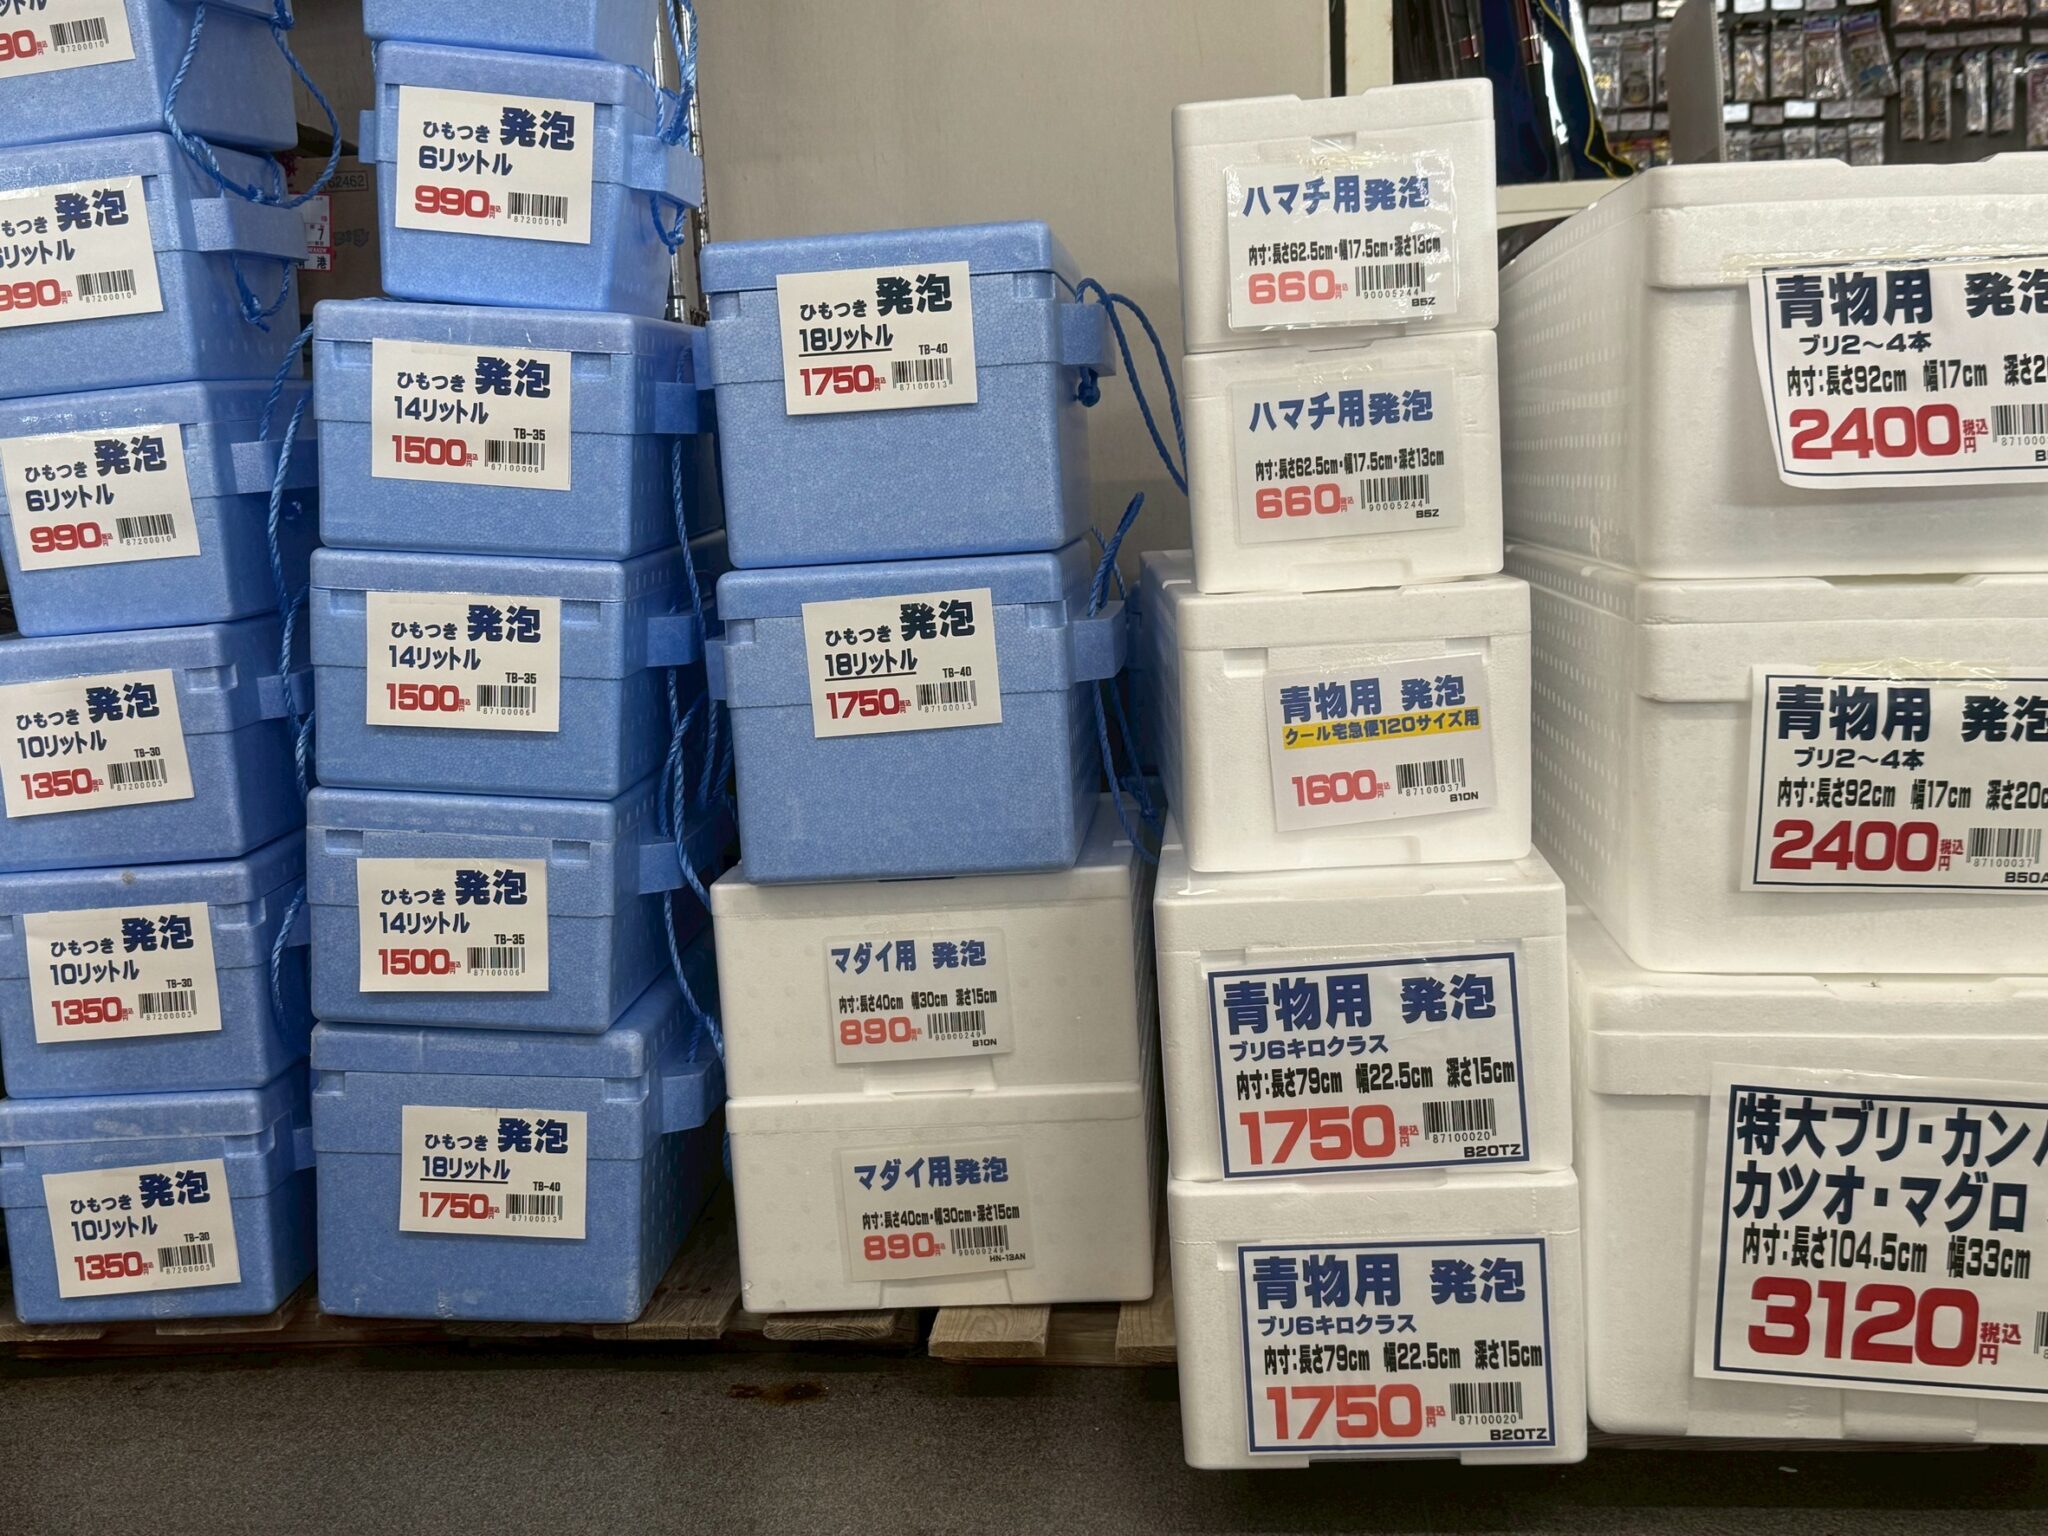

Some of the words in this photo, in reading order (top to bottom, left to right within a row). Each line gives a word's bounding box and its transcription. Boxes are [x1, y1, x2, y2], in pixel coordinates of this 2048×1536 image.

[423, 121, 490, 143] ひもつき
[500, 107, 574, 151] 発泡
[419, 145, 513, 176] 6リットル
[55, 189, 129, 232] 発泡
[415, 185, 490, 218] 990
[1243, 175, 1429, 217] ハマチ用発泡
[514, 217, 561, 226] 87200010
[801, 300, 867, 321] ひもつき
[876, 274, 952, 316] 発泡
[1249, 269, 1335, 305] 660
[1775, 269, 1933, 328] 青物用
[1964, 269, 2048, 318] 発泡
[799, 324, 893, 352] 18リットル
[918, 343, 948, 355] TB-40
[397, 372, 465, 392] ひもつき
[475, 357, 550, 398] 発泡
[800, 364, 875, 396] 1750
[1923, 360, 1987, 392] 幅17cm
[2004, 354, 2048, 387] 深さ2
[395, 396, 489, 424] 14リットル
[1249, 389, 1433, 432] ハマチ用発泡
[513, 428, 545, 440] TB-35
[1789, 403, 1961, 460] 2400
[1962, 418, 1988, 436] 税込
[25, 462, 87, 482] ひもつき
[94, 435, 166, 476] 発泡
[392, 435, 467, 467] 1500
[1964, 436, 1976, 454] 円
[26, 484, 114, 512] 6リットル
[1256, 483, 1341, 519] 660
[30, 522, 102, 553] 990
[126, 536, 171, 546] 87200010
[392, 622, 457, 640] ひもつき
[467, 605, 541, 643] 発泡
[825, 625, 891, 646] ひもつき
[900, 600, 975, 641] 発泡
[389, 645, 481, 670] 14リットル
[825, 649, 918, 676] 18リットル
[942, 666, 972, 678] TB-40
[505, 672, 537, 684] TB-35
[16, 709, 79, 730] ひもつき
[86, 683, 159, 723] 発泡
[387, 683, 459, 712] 1500
[826, 688, 900, 719] 1750
[1280, 678, 1382, 724] 青物用
[1401, 675, 1466, 711] 発泡
[1776, 684, 1931, 742] 青物用
[1961, 695, 2048, 742] 発泡
[1285, 709, 1479, 746] クール宅急便120サイズ用
[17, 730, 107, 759] 10リットル
[134, 747, 160, 758] TB-30
[21, 768, 93, 800] 1350
[117, 781, 162, 791] 87200003
[1292, 769, 1377, 806] 1600
[1406, 783, 1459, 797] 87100037
[1910, 778, 1972, 810] 幅17cm
[1770, 819, 1939, 872] 2400
[1940, 838, 1964, 855] 税込
[1938, 855, 1950, 872] 円
[1973, 858, 2033, 868] 87100037
[381, 889, 445, 905] ひもつき
[455, 870, 528, 905] 発泡
[51, 938, 114, 957] ひもつき
[121, 915, 193, 953] 発泡
[380, 911, 470, 935] 14リットル
[494, 934, 525, 945] TB-35
[50, 960, 139, 985] 10リットル
[379, 949, 450, 975] 1500
[831, 940, 917, 974] マダイ用
[932, 940, 986, 970] 発泡
[166, 978, 192, 988] TB-30
[51, 996, 123, 1026] 1350
[911, 992, 948, 1009] 幅30cm
[1223, 973, 1372, 1036] 青物用
[1400, 974, 1496, 1024] 発泡
[840, 1016, 911, 1046] 890
[1229, 1035, 1389, 1062] ブリ6キロクラス
[1356, 1062, 1433, 1094] 幅22.5cm
[1446, 1057, 1515, 1088] 深さ15cm
[425, 1134, 488, 1151] ひもつき
[498, 1118, 568, 1153] 発泡
[1240, 1104, 1396, 1165] 1750
[1432, 1131, 1490, 1144] 87100020
[422, 1156, 510, 1179] 18リットル
[854, 1156, 1008, 1191] マダイ用発泡
[70, 1195, 132, 1214] ひもつき
[139, 1170, 210, 1209] 発泡
[533, 1182, 560, 1191] TB-40
[1732, 1160, 2028, 1232] カツオ・マグロ
[420, 1192, 489, 1219] 1750
[71, 1215, 158, 1241] 10リットル
[184, 1232, 209, 1242] TB-30
[864, 1232, 935, 1261] 890
[1948, 1234, 2031, 1279] 幅33cm
[74, 1251, 143, 1281] 1350
[1253, 1253, 1401, 1310] 青物用
[1430, 1257, 1526, 1305] 発泡
[1257, 1314, 1417, 1337] ブリ6キロクラス
[1748, 1276, 1979, 1368] 3120
[1979, 1322, 2022, 1346] 税込
[1384, 1342, 1461, 1372] 幅22.5cm
[1474, 1339, 1543, 1371] 深さ15cm
[1978, 1343, 1999, 1365] 円
[1266, 1383, 1422, 1440] 1750
[1459, 1414, 1517, 1425] 87100020
